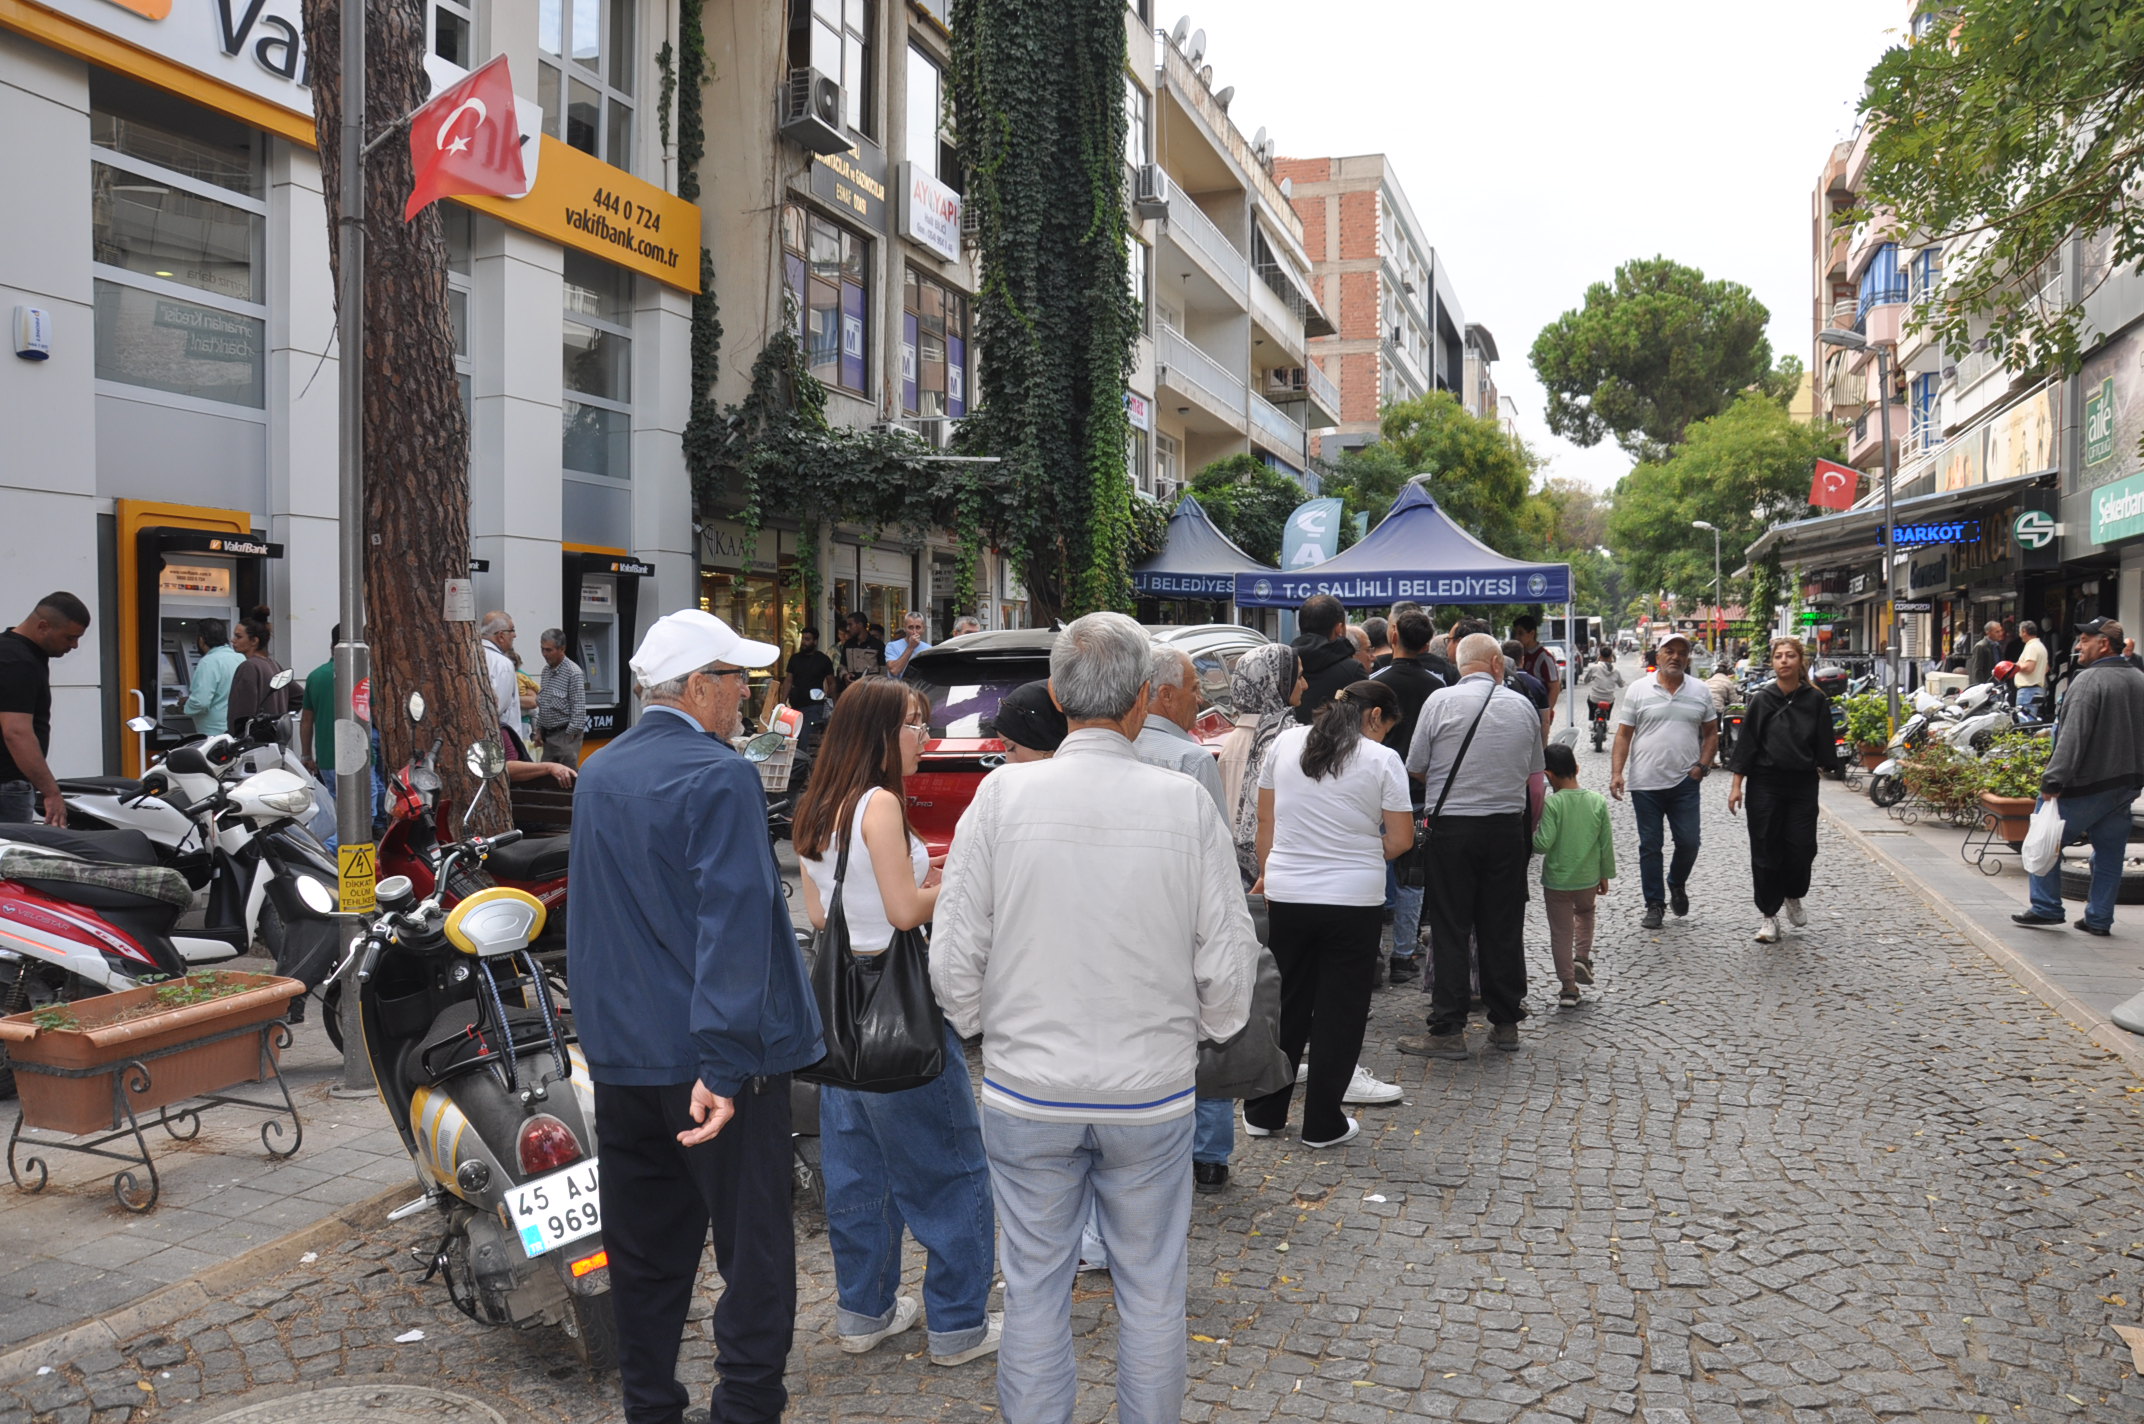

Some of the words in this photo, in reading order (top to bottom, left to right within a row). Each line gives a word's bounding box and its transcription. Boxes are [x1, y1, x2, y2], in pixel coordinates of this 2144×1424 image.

[593, 187, 619, 215] 444
[623, 200, 633, 220] 0
[636, 205, 661, 233] 724
[565, 207, 679, 268] vakifbank.com.tr
[2088, 397, 2112, 444] aile
[715, 530, 758, 558] KAA
[1892, 524, 1965, 543] BARKOT
[1152, 575, 1235, 593] BELEDİYES
[1317, 577, 1392, 599] SALİHLİ
[1399, 576, 1517, 597] BELEDİYESİ
[593, 715, 614, 727] TAM
[342, 896, 375, 906] TEHLİKES
[18, 908, 70, 931] VELOSTAR
[518, 1186, 550, 1217] 45
[566, 1167, 598, 1200] AJ
[547, 1202, 599, 1240] 969
